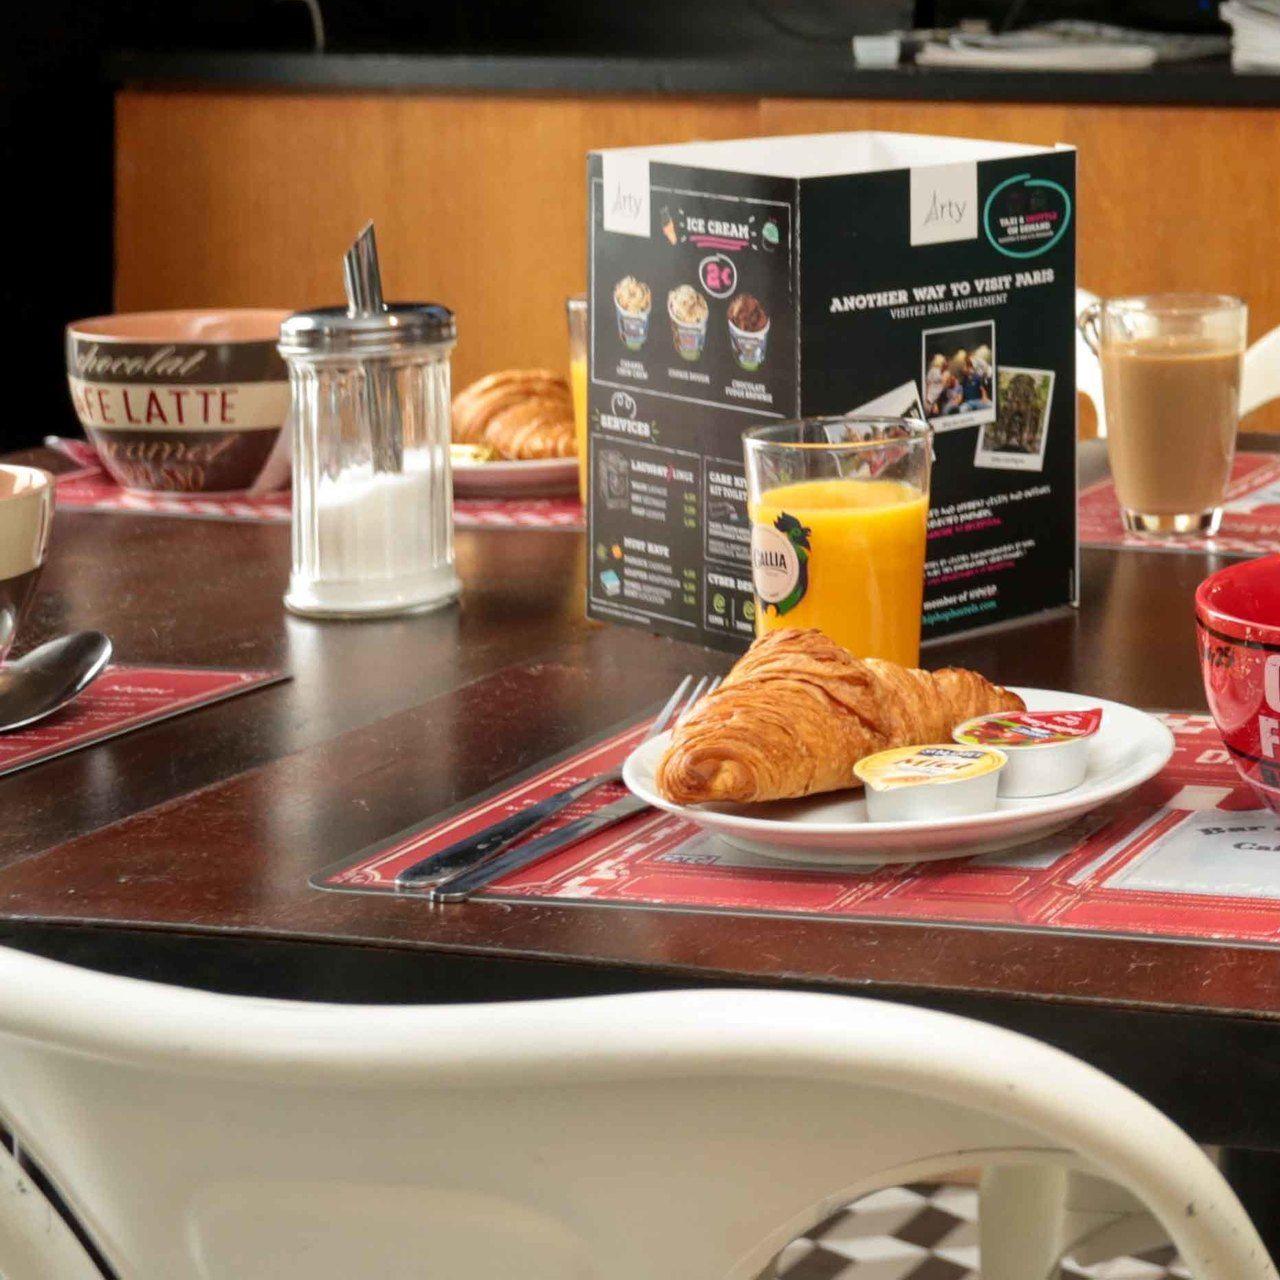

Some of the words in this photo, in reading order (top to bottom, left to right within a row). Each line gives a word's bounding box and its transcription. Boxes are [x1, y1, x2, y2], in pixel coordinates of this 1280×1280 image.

[613, 182, 644, 218] Arty
[924, 189, 967, 226] Arty
[687, 217, 706, 234] ICE
[708, 220, 750, 240] CREAM
[829, 289, 910, 315] ANOTHER
[912, 283, 947, 303] WAY
[950, 279, 972, 298] TO
[974, 273, 1013, 294] VISIT
[1015, 268, 1056, 289] PARIS
[928, 300, 955, 317] PARIS
[955, 292, 1009, 312] AUTREMENT
[122, 387, 238, 426] LATTE
[601, 414, 651, 438] SERVICES
